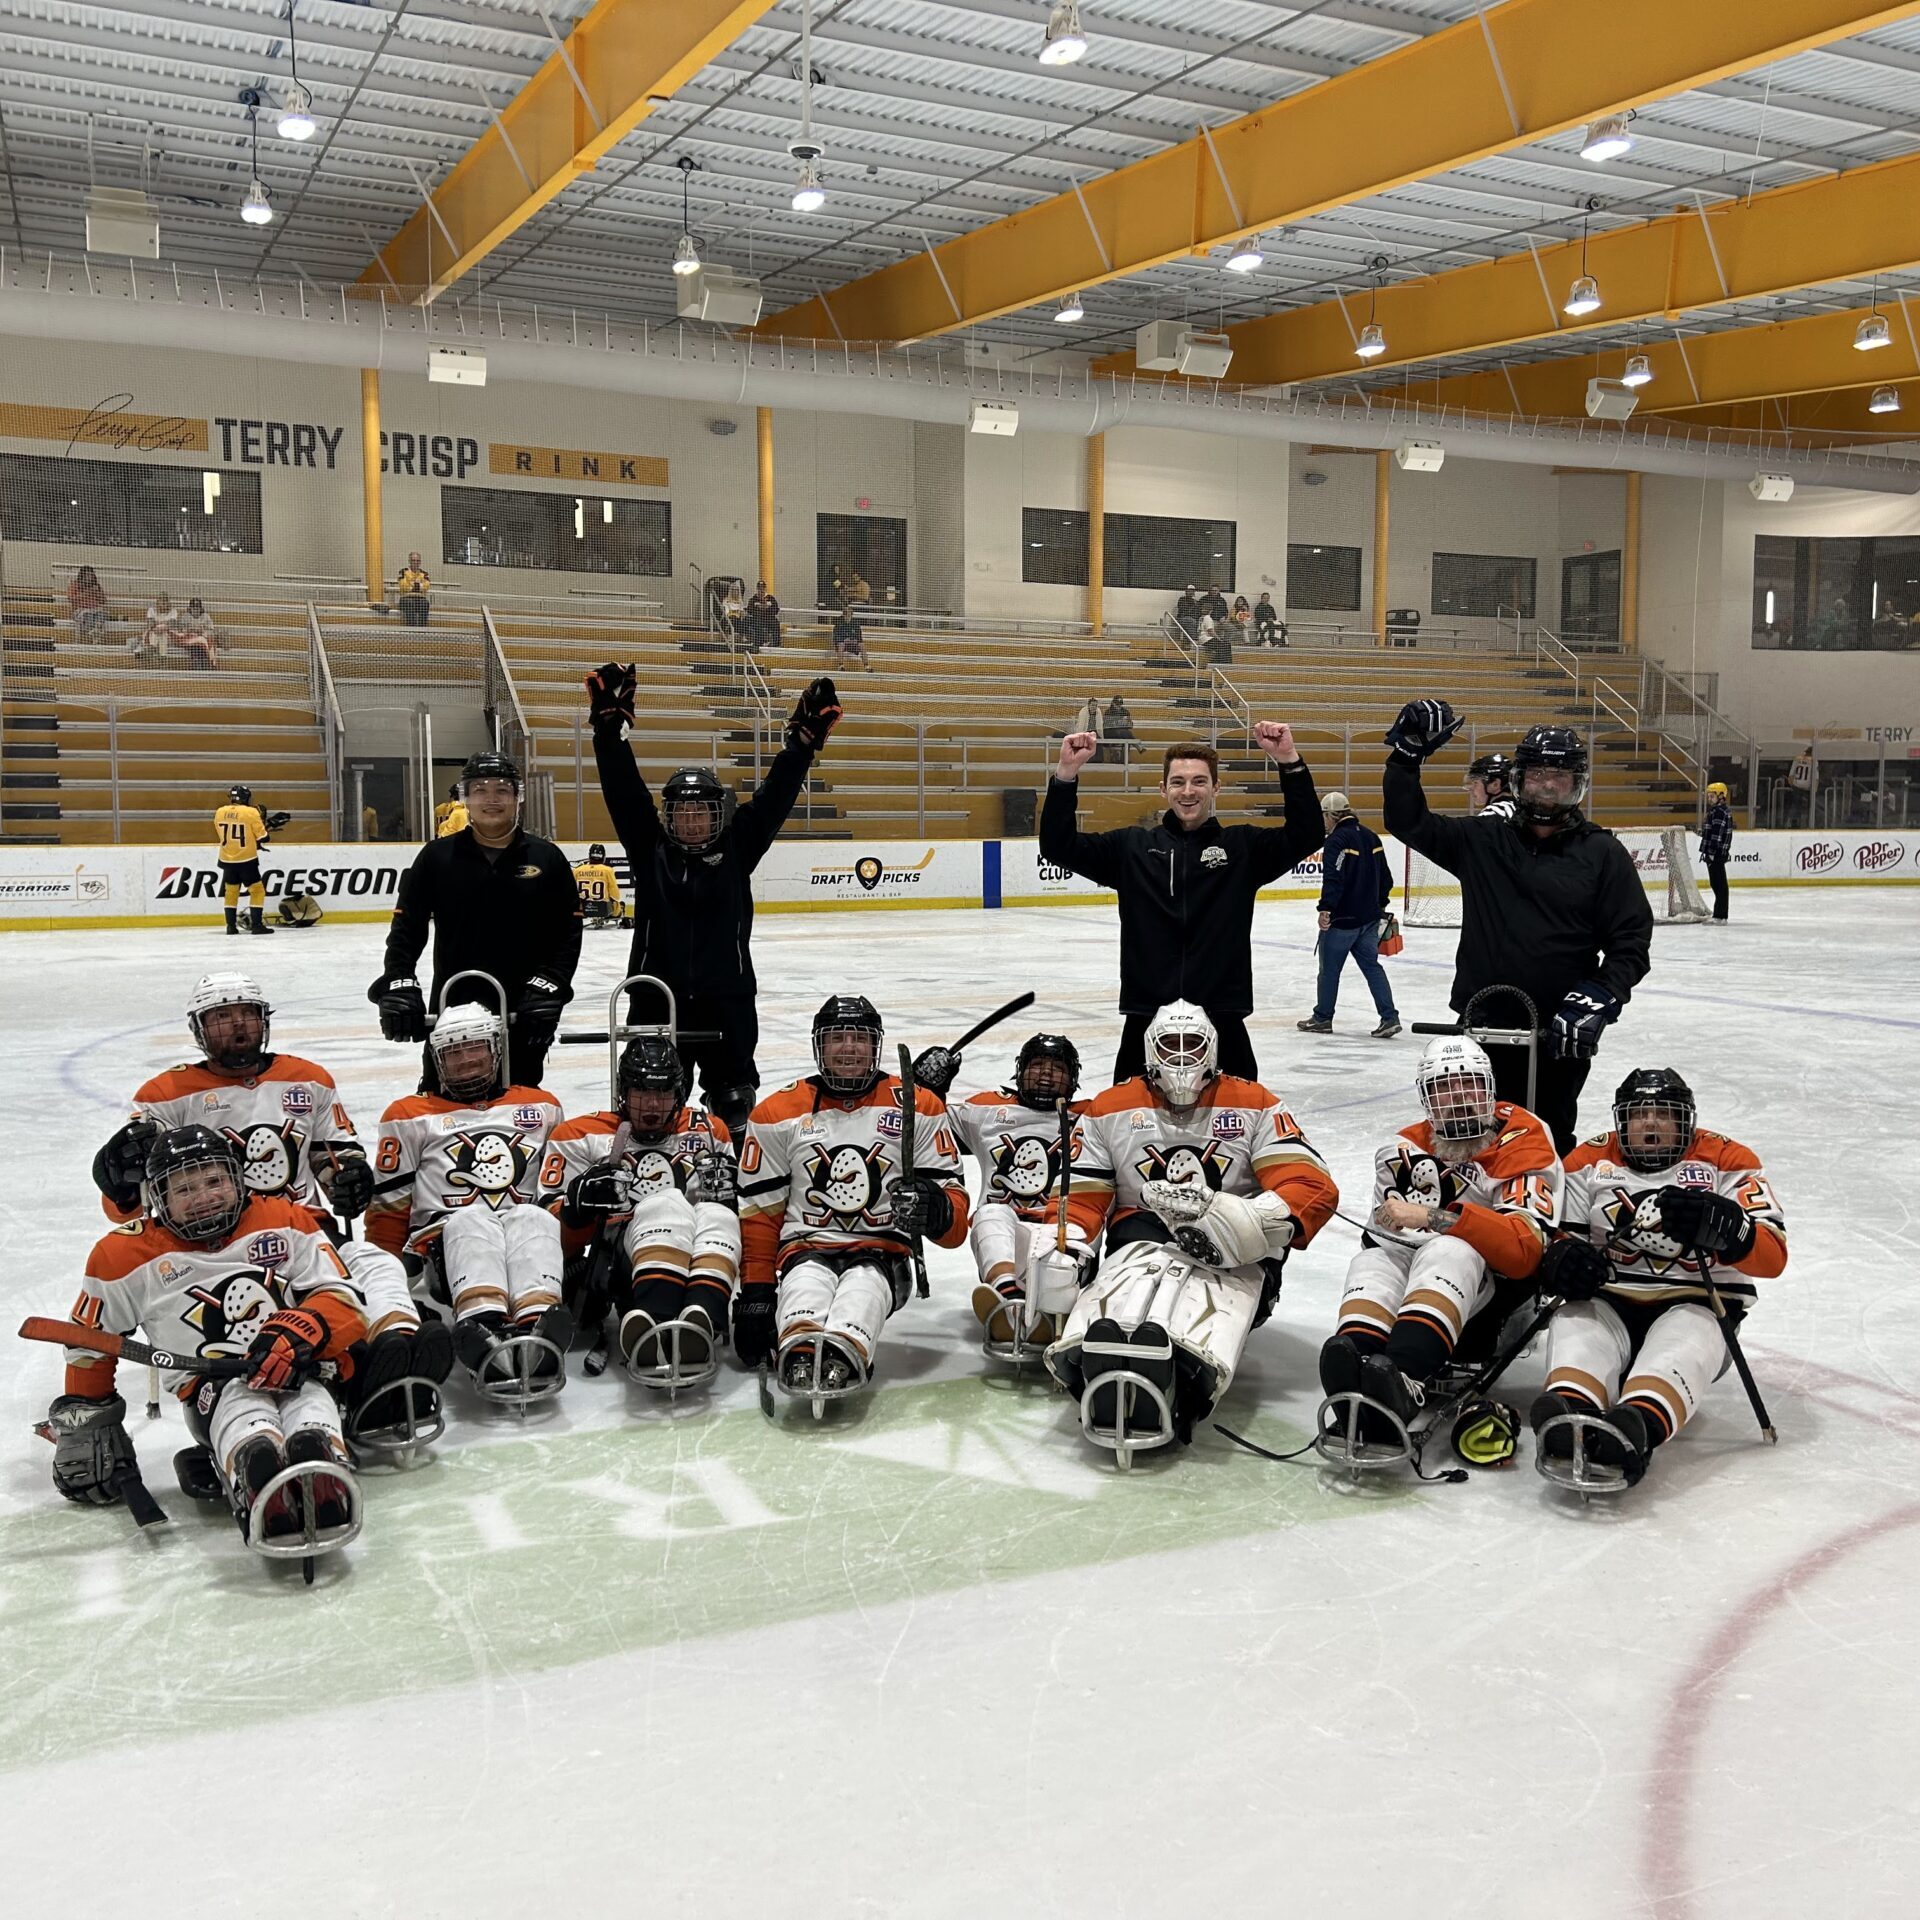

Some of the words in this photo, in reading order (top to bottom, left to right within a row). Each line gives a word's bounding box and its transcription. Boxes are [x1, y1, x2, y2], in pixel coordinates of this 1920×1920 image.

[215, 417, 344, 469] TERRY
[516, 452, 636, 479] RINK
[1865, 727, 1913, 742] TERRY
[218, 823, 246, 848] 74
[1734, 852, 1762, 862] need.
[1801, 846, 1840, 871] Pepper
[1813, 843, 1830, 857] Dr
[1859, 846, 1901, 870] Pepper
[1872, 842, 1889, 856] Dr
[156, 867, 404, 899] BRGESTON
[811, 875, 854, 885] DRAFT
[882, 873, 920, 883] PICKS
[1039, 868, 1073, 880] CLUB
[578, 881, 605, 900] 59
[283, 1094, 312, 1105] SLED
[514, 1110, 542, 1121] SLED
[688, 1110, 714, 1130] A
[878, 1114, 902, 1129] SLE
[1212, 1117, 1245, 1130] SLED
[376, 1136, 401, 1173] 8
[741, 1135, 762, 1175] 0
[540, 1153, 566, 1188] 8
[1676, 1170, 1712, 1184] SLED
[1500, 1174, 1555, 1220] 45
[248, 1239, 288, 1260] SLED
